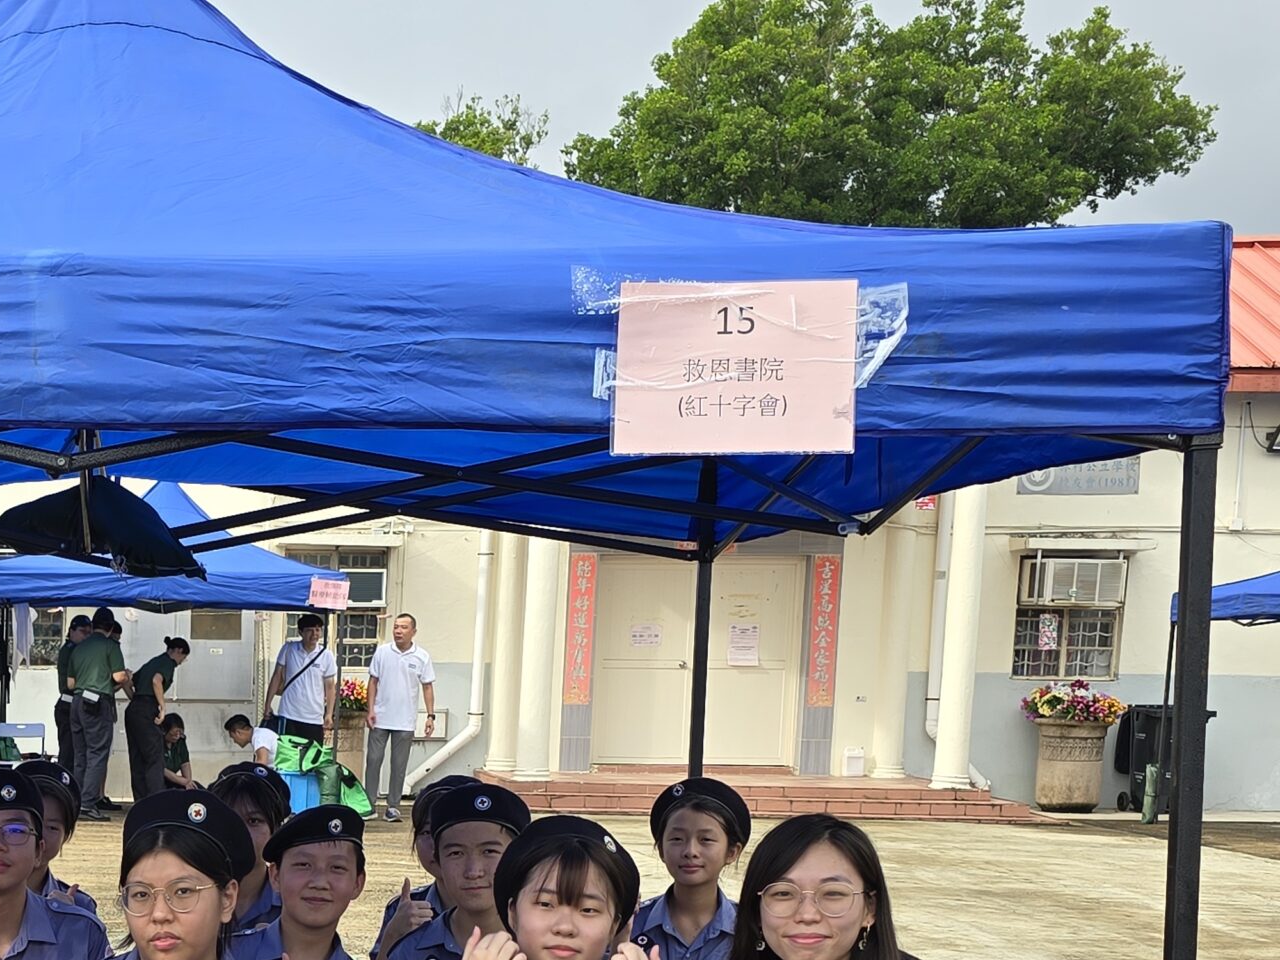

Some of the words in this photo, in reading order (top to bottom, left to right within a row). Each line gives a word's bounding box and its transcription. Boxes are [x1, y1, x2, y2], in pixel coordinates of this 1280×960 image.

[715, 306, 755, 335] 15
[682, 357, 784, 383] 救恩書院
[677, 393, 788, 418] (紅十字會)
